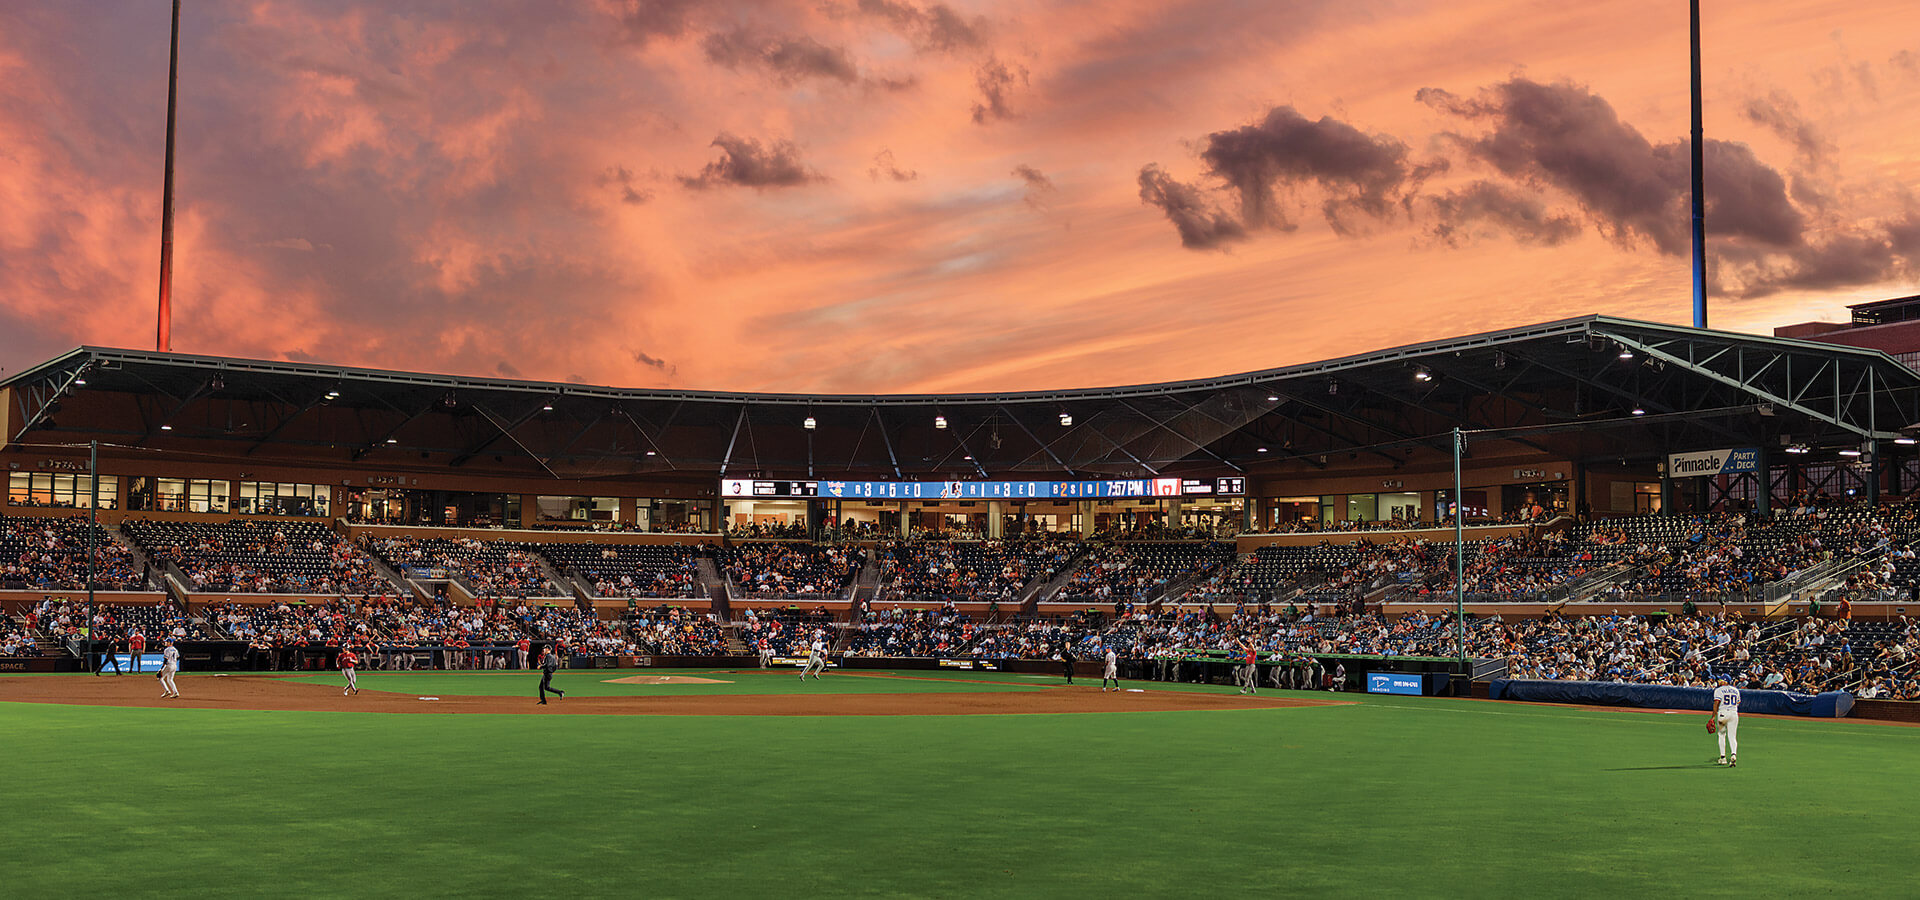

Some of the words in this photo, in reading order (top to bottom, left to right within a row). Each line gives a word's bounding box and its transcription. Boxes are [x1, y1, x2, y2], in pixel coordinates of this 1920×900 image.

[1674, 455, 1720, 472] Pinnacle
[1734, 452, 1755, 460] PARTY
[1737, 461, 1755, 469] DECK
[864, 482, 872, 497] 3
[880, 485, 885, 495] H
[904, 485, 909, 495] E
[914, 483, 921, 497] 0
[981, 483, 985, 497] 1
[994, 485, 1000, 494] H
[1003, 482, 1011, 497] 3
[1019, 484, 1023, 494] E
[1028, 482, 1035, 497] 0
[1053, 484, 1058, 494] B
[1060, 482, 1067, 497] 2
[1070, 484, 1076, 494] S
[1106, 481, 1126, 496] 7:57
[1127, 480, 1143, 496] PM
[1723, 695, 1737, 705] 50
